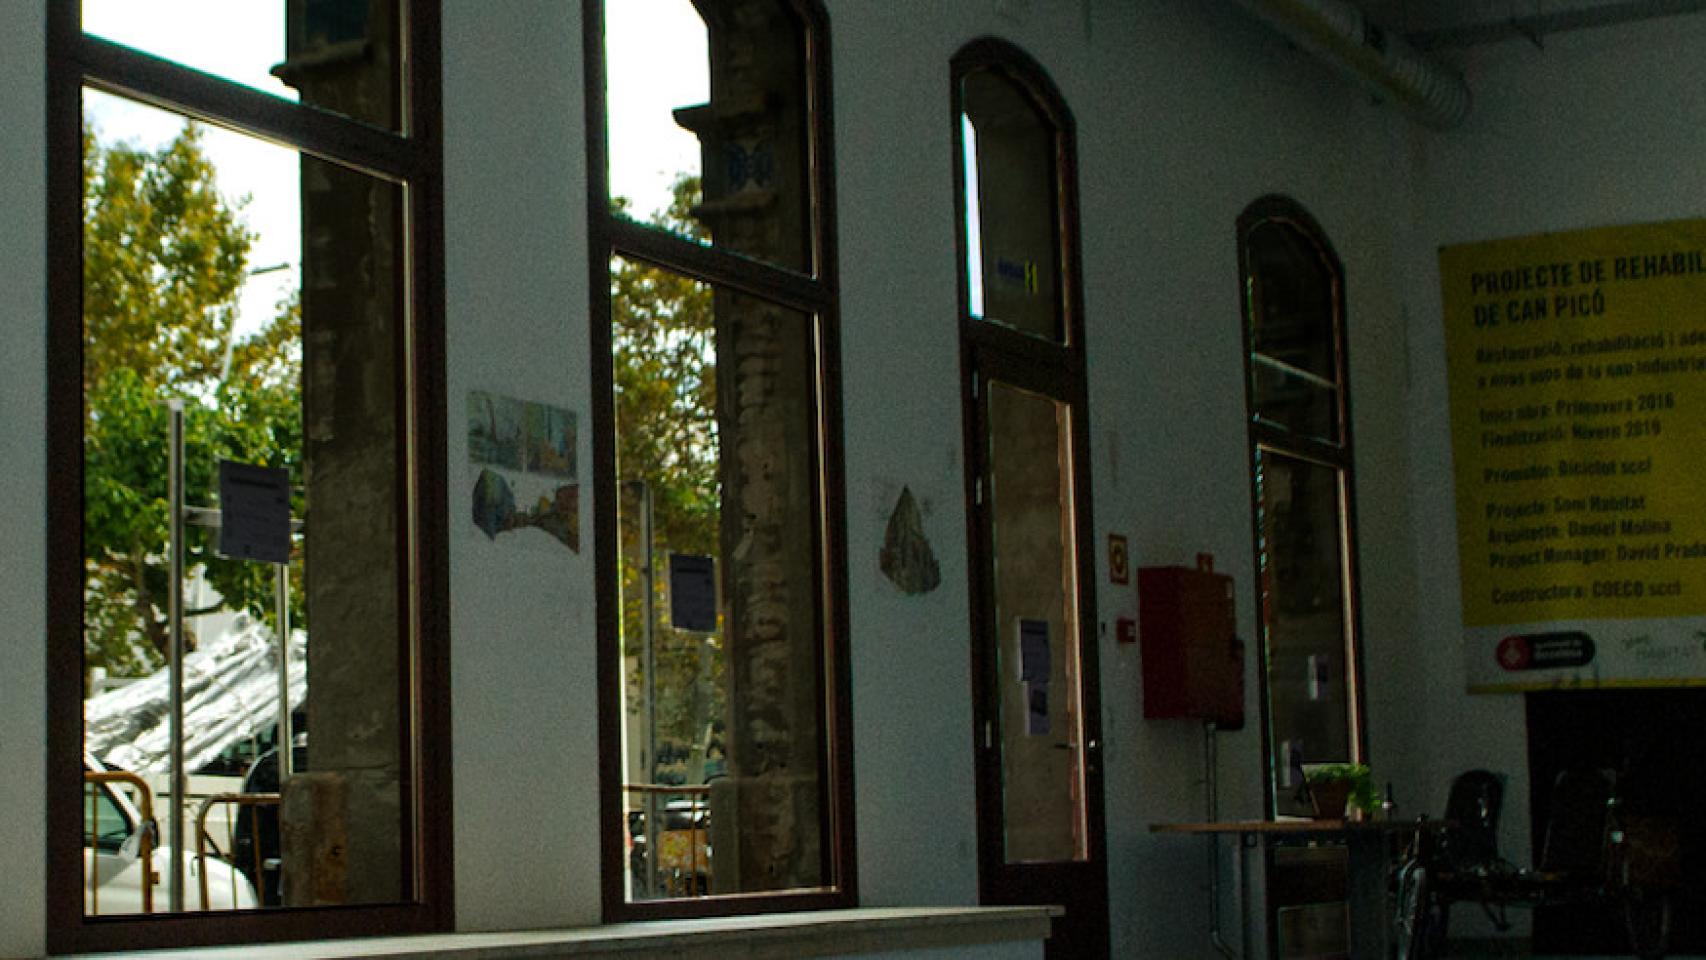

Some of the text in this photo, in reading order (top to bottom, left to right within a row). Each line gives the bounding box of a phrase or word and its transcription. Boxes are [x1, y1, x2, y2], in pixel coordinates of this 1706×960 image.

[1471, 251, 1706, 294] PROJECTE DE REHABIL
[1473, 288, 1605, 328] DE CAN PICÓ
[1555, 399, 1633, 417] Primavera
[1590, 494, 1646, 513] Habitat
[1568, 520, 1616, 538] Daniel
[1620, 517, 1671, 535] Molina
[1617, 543, 1659, 561] David
